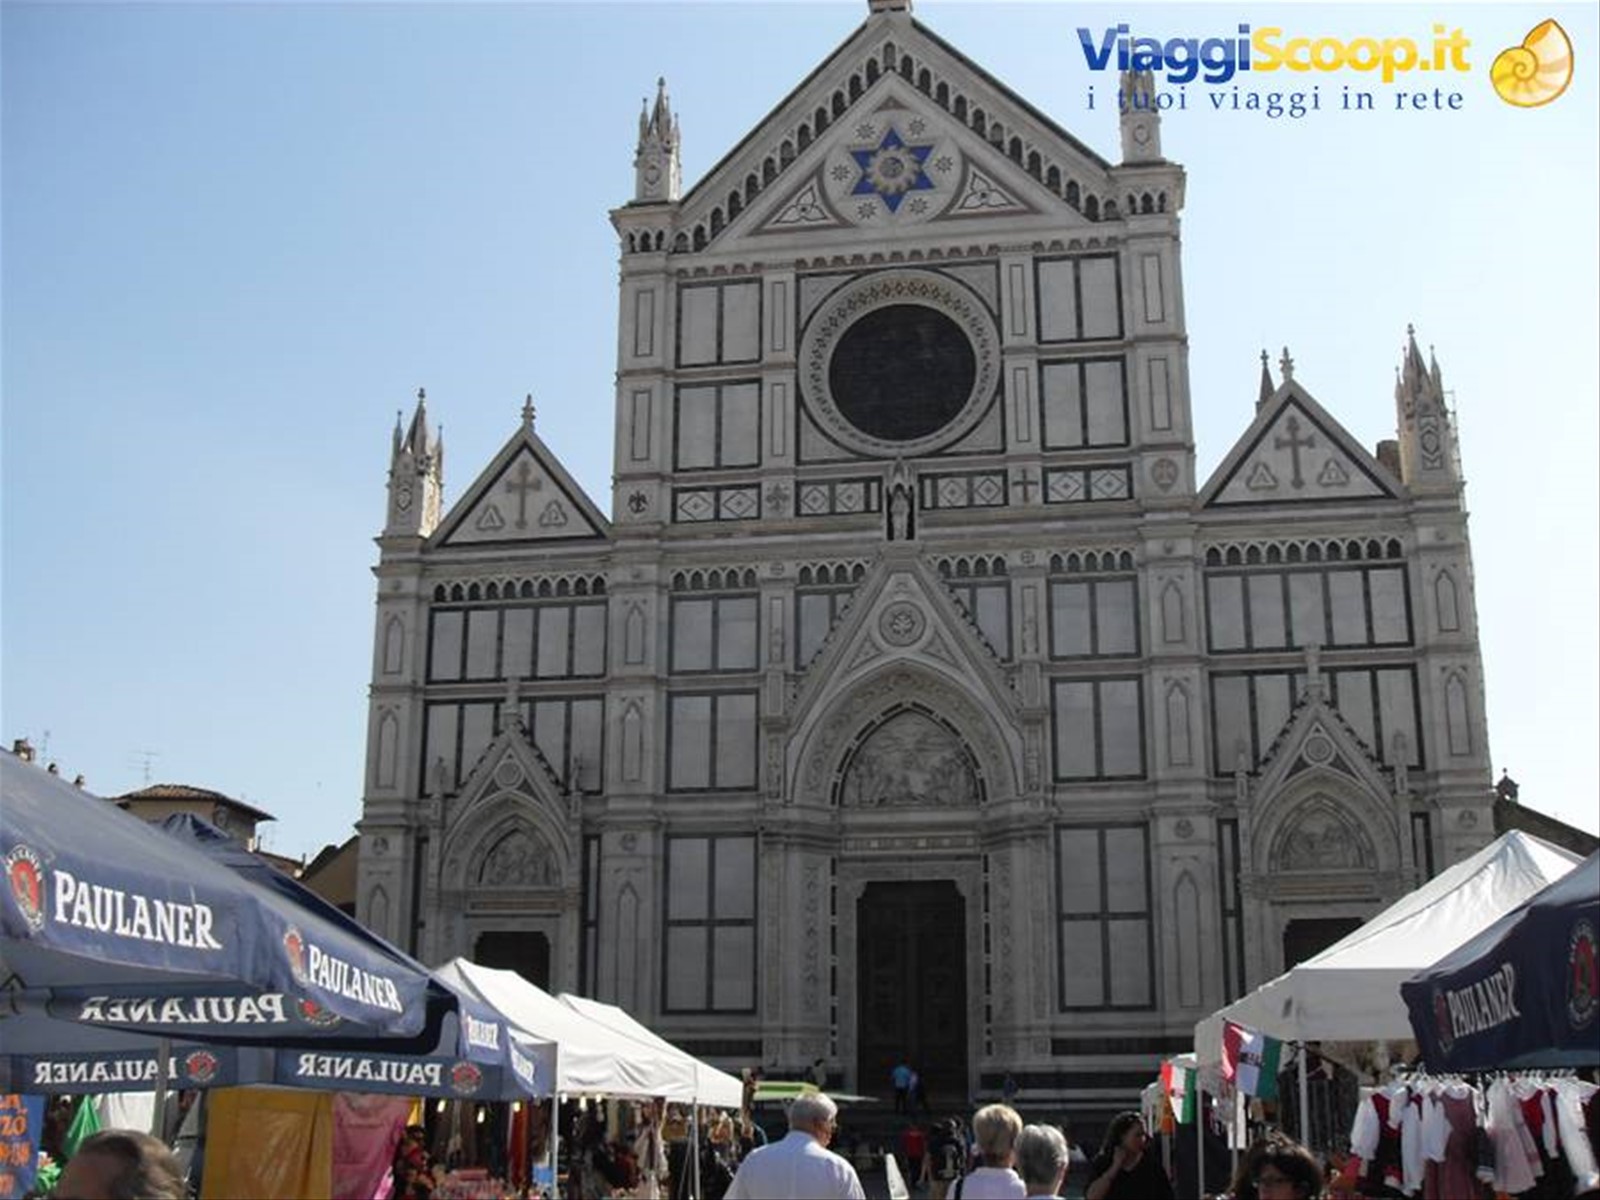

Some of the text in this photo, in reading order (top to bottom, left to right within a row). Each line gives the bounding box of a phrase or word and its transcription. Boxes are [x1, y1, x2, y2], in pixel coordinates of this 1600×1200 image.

[53, 870, 223, 950] PAULANER
[308, 943, 403, 1013] PAULANER
[1446, 962, 1521, 1039] PAULANER
